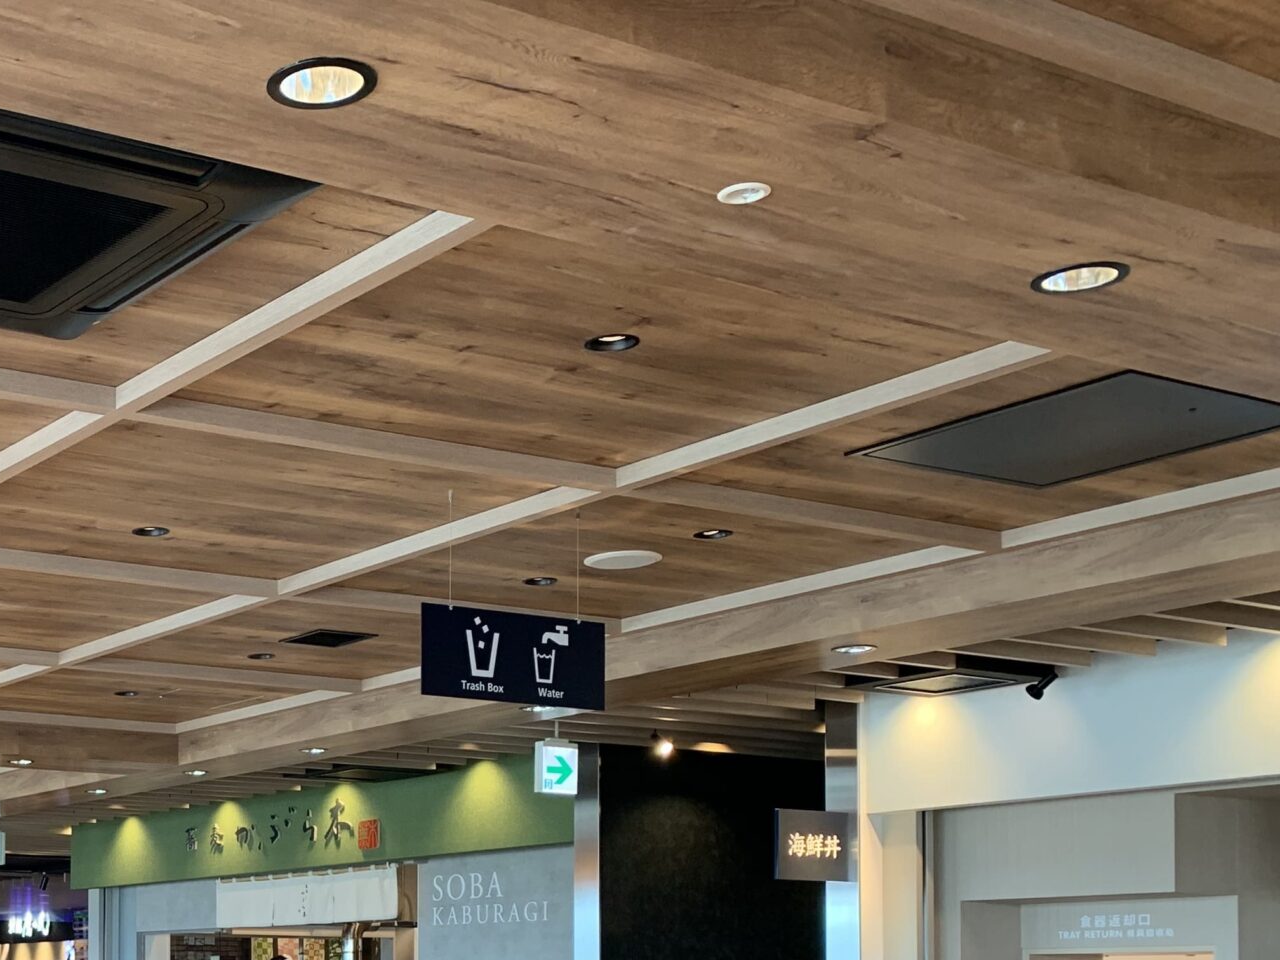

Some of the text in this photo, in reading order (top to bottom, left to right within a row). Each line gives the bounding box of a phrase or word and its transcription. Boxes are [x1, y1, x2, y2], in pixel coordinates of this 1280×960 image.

[461, 680, 504, 693] Trash Box
[538, 687, 564, 699] Water
[787, 832, 842, 859] 海鮮丼
[432, 871, 504, 902] SOBA
[432, 901, 549, 926] KABURAGI
[1058, 930, 1081, 940] TRAY
[1084, 928, 1123, 939] RETURN
